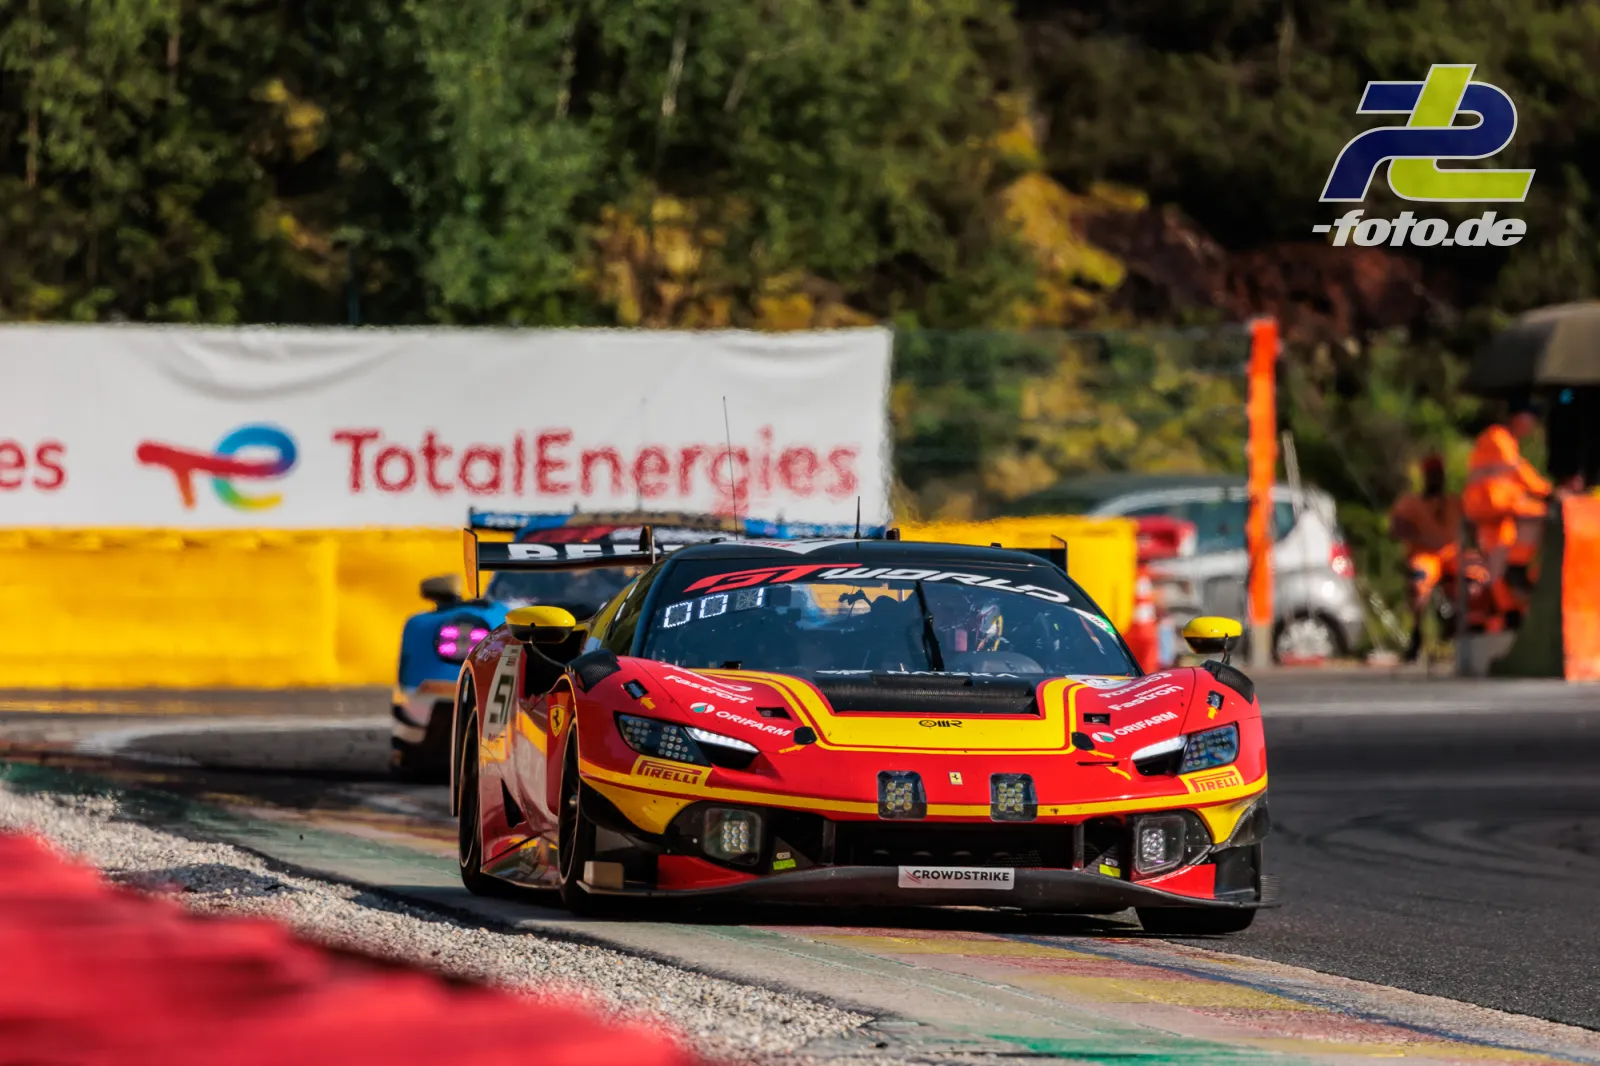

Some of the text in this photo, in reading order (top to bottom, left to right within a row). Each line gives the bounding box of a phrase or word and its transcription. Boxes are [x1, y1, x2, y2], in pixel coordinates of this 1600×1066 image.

[332, 424, 861, 518] TotalEnergies
[683, 564, 863, 595] GT
[1108, 685, 1184, 711] Fastron
[716, 711, 792, 737] ORIFARM
[1114, 711, 1179, 736] ORIFARM
[636, 760, 703, 785] PIRELLI
[1188, 770, 1239, 793] PIRELLI
[912, 870, 1010, 881] CROWDSTRIKE
